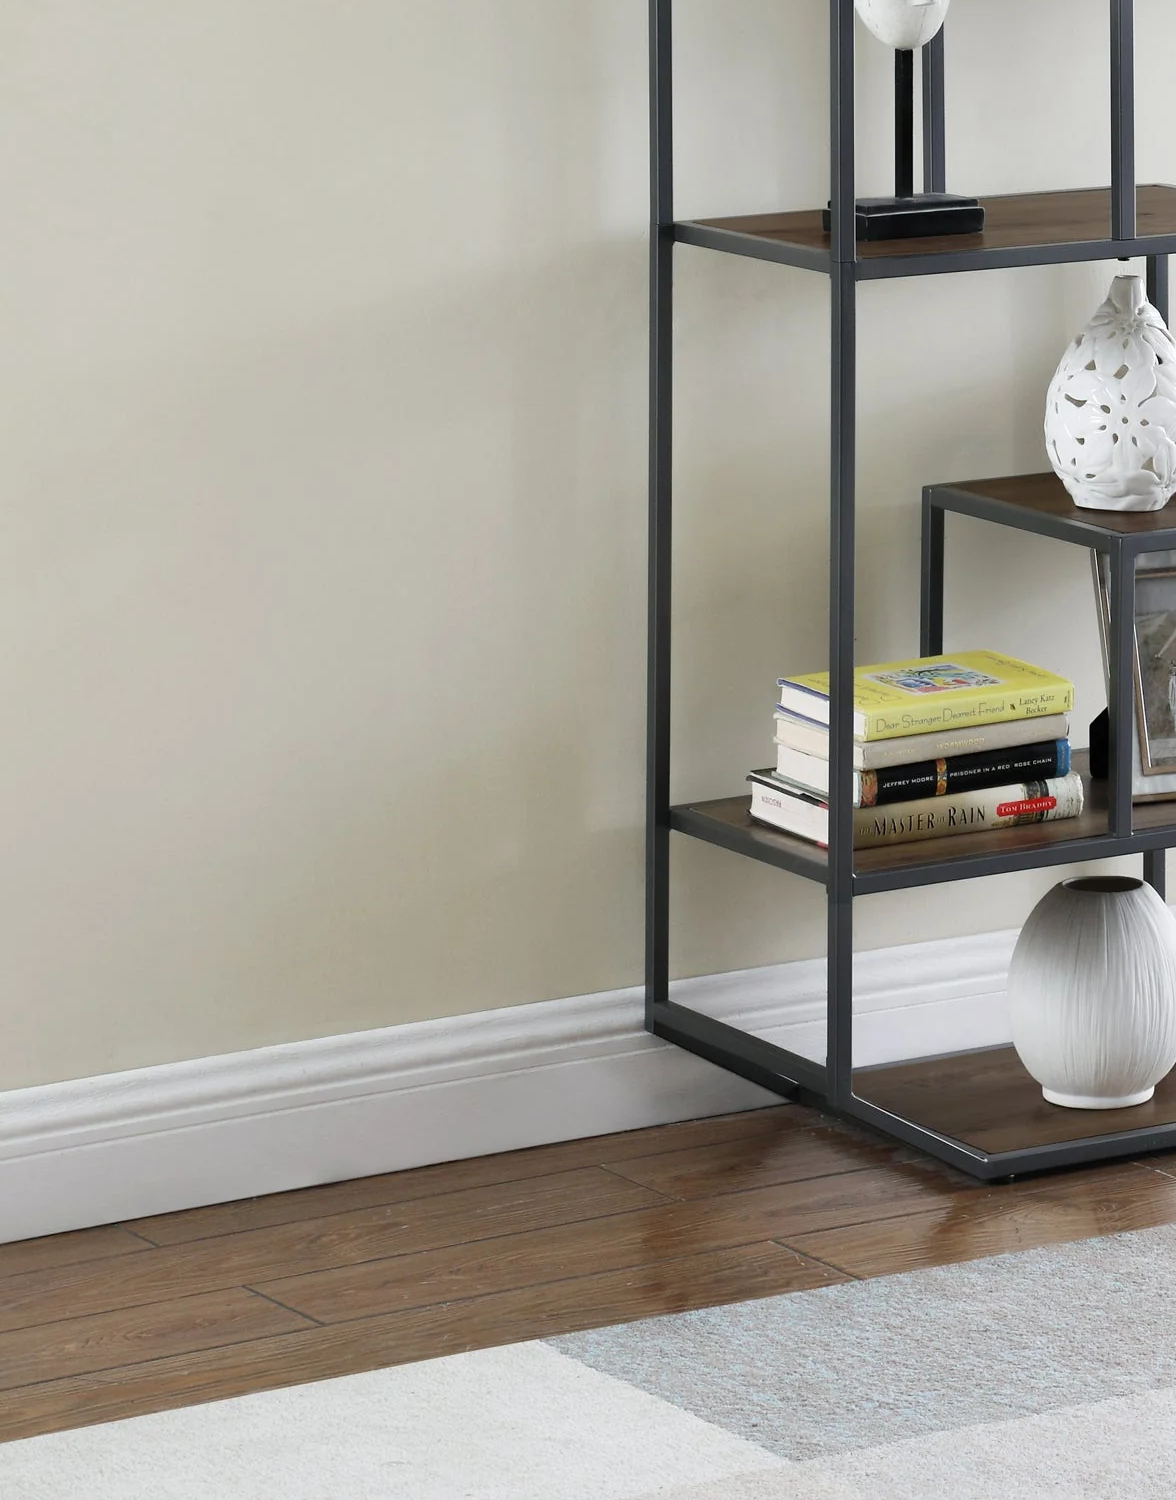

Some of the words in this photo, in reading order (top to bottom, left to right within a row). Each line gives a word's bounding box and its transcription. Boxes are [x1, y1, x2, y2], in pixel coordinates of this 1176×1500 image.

[1019, 697, 1038, 706] Laney
[1040, 694, 1055, 703] Katz
[876, 718, 899, 733] Dear
[942, 707, 976, 723] Dearest
[979, 699, 1005, 717] Friend
[1025, 705, 1048, 715] Becker
[949, 768, 982, 778] PRISONER
[882, 779, 910, 789] JEFFREY
[911, 775, 934, 784] MOORE
[1000, 806, 1018, 814] TOM
[874, 812, 935, 837] MASTER
[947, 805, 986, 827] RAIN
